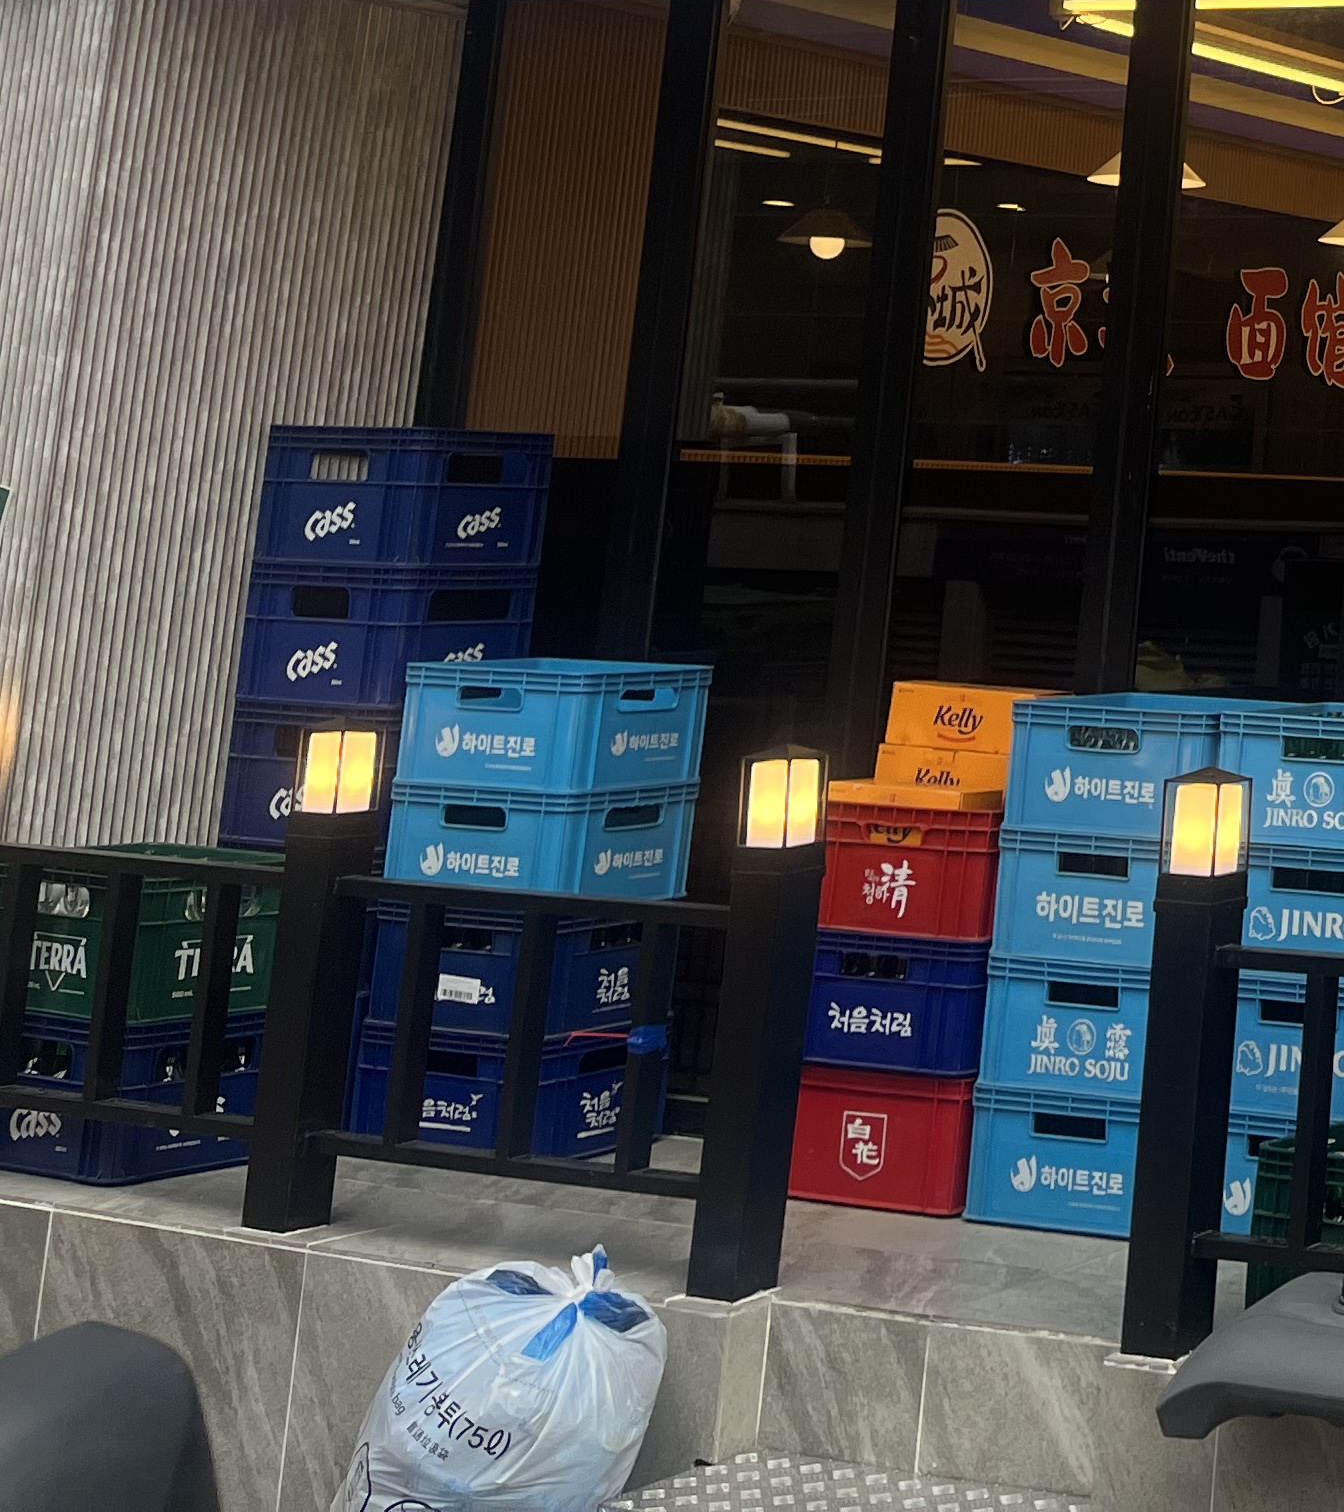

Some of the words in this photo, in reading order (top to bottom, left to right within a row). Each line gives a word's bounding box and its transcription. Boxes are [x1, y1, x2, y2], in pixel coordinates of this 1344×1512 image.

[933, 705, 983, 736] Kelly
[461, 732, 536, 759] 하이트진로
[628, 732, 679, 752] 하이트진로
[1074, 775, 1155, 805] 하이트진로
[1263, 807, 1318, 829] JINRO
[446, 850, 520, 878] 하이트진로
[612, 848, 663, 870] 하이트진로
[1036, 890, 1145, 929] 하이트진로
[828, 1002, 912, 1037] 처음처럼
[1027, 1053, 1080, 1076] JINRO
[1084, 1059, 1129, 1082] SOJU
[422, 1098, 472, 1121] 음처럼
[1041, 1165, 1123, 1195] 하이트진로
[391, 1392, 406, 1416] bag
